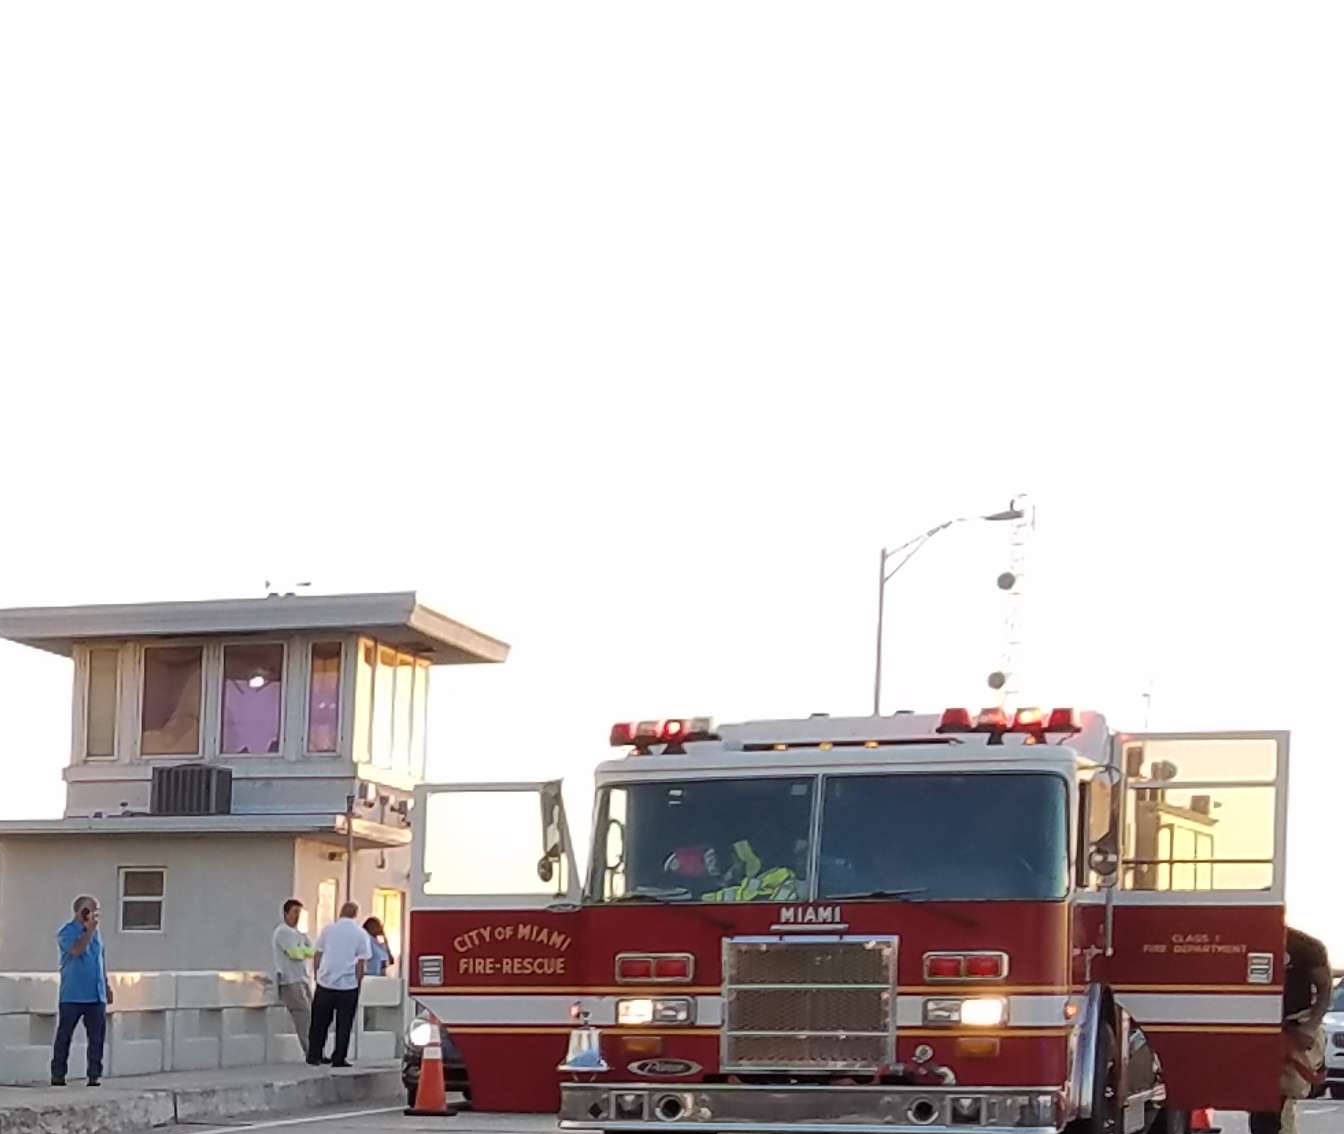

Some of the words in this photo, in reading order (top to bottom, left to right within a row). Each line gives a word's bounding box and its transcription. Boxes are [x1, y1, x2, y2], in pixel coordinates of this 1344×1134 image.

[780, 906, 841, 922] MIAMI
[454, 926, 491, 952] CITY
[494, 926, 513, 940] OF
[517, 923, 571, 952] MIAMI
[1172, 934, 1209, 943] CLASS
[1143, 944, 1167, 953] FIRE
[1173, 944, 1247, 953] DEPARTMENT
[459, 958, 565, 974] FIRE-RESCUE
